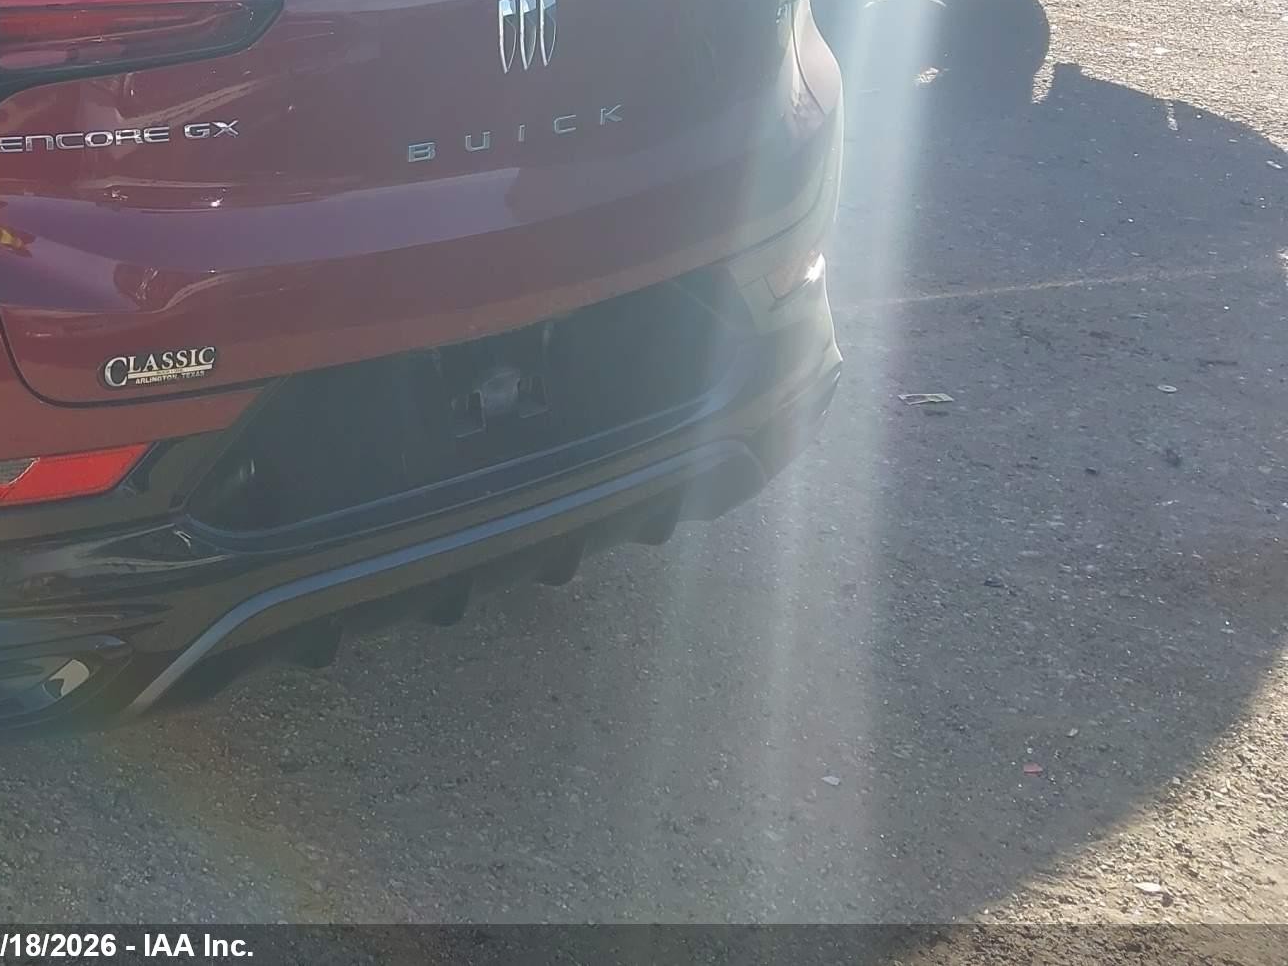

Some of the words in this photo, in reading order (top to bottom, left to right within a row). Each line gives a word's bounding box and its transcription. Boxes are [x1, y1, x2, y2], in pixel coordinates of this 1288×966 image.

[184, 120, 239, 139] GX
[408, 104, 623, 162] BUICK
[104, 346, 215, 387] CLASSIC
